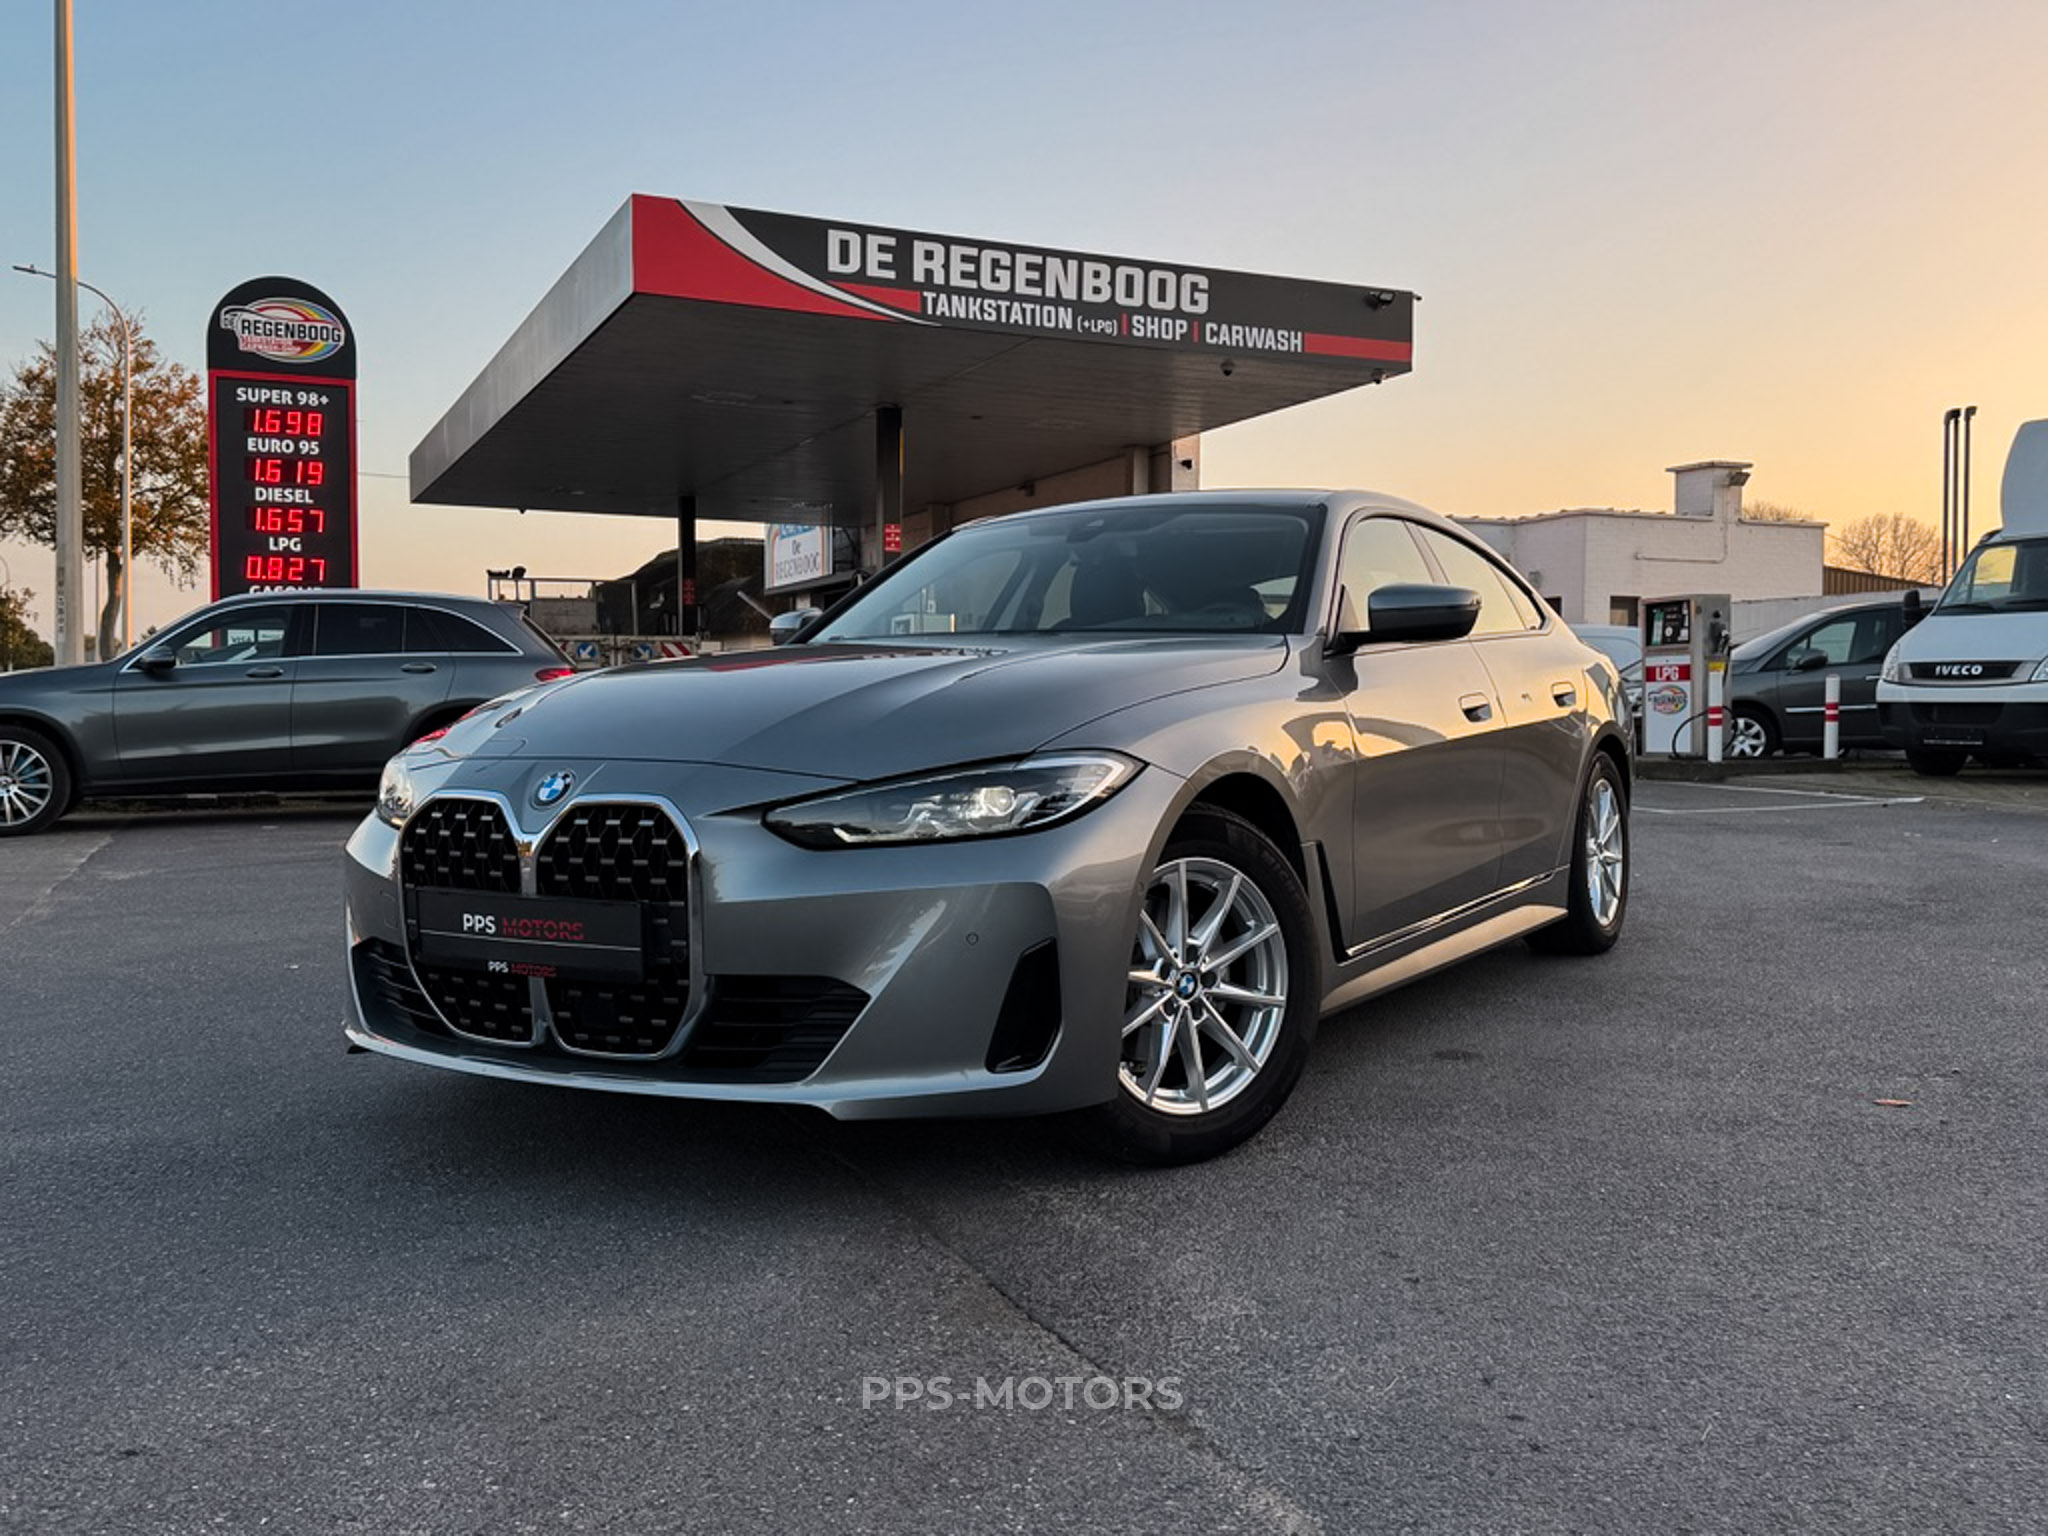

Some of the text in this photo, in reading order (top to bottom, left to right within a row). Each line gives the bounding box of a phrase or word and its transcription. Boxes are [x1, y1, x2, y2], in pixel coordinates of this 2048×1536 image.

[827, 229, 1210, 314] DE REGENBOOG
[241, 318, 342, 343] REGENBOOG
[923, 290, 1303, 353] TANKSTATION (+LPG) SHOP CARWASH
[236, 387, 330, 407] SUPER 98+
[253, 408, 323, 437] 1.698
[247, 437, 320, 455] EURO 95
[255, 487, 315, 504] DIESEL
[254, 506, 325, 534] 1.657
[268, 536, 302, 552] LPG
[245, 554, 326, 582] 0.827
[1655, 666, 1680, 681] LPG
[1935, 664, 1984, 676] IVECO
[462, 912, 585, 941] PPS MOTORS
[487, 960, 509, 974] PPS
